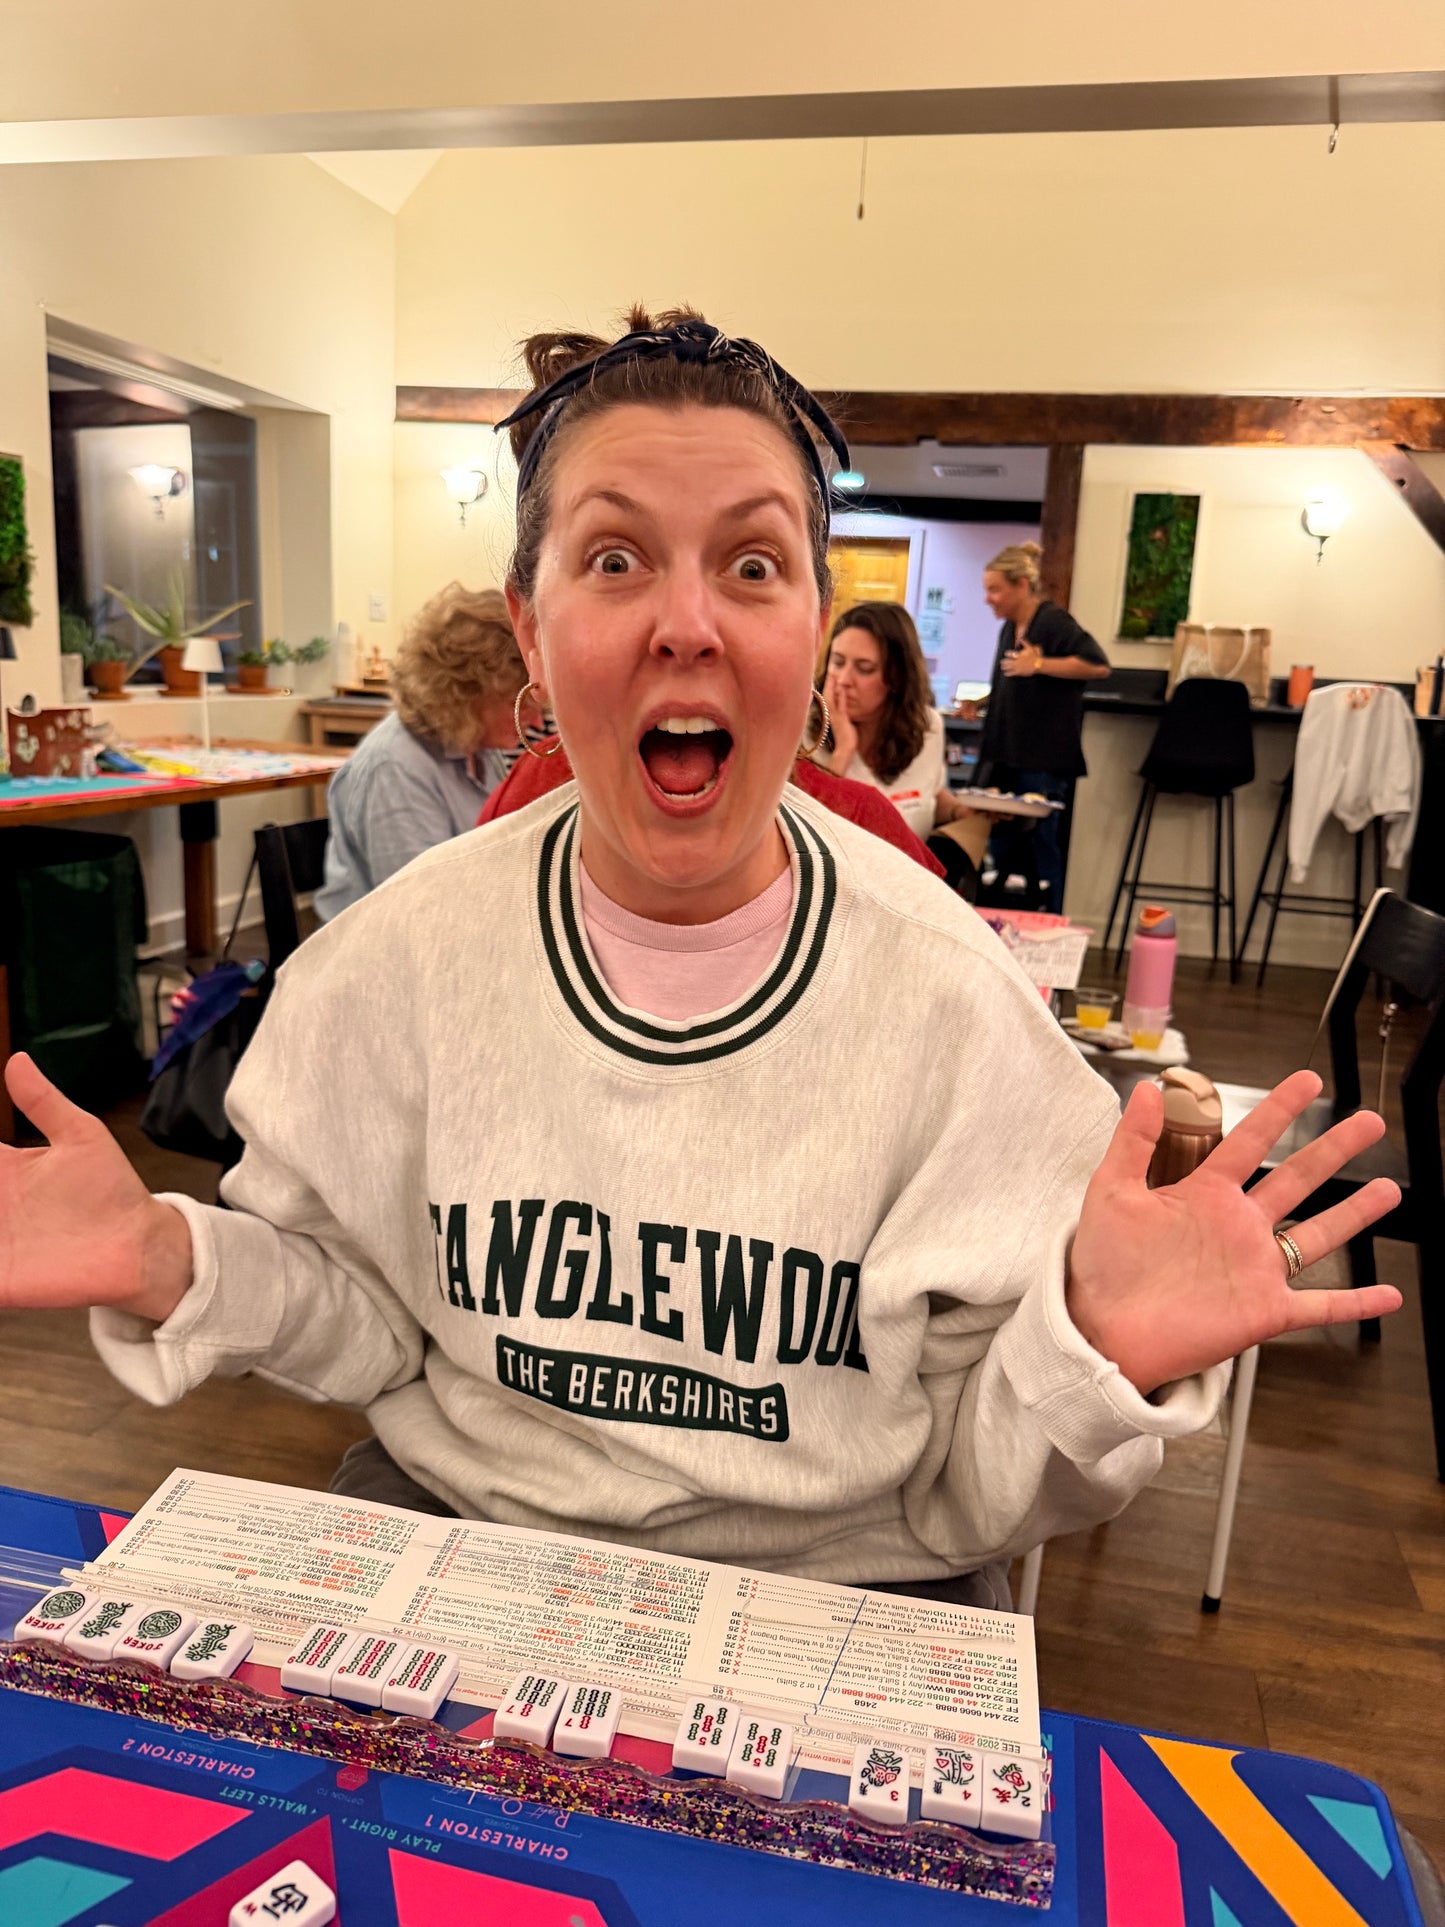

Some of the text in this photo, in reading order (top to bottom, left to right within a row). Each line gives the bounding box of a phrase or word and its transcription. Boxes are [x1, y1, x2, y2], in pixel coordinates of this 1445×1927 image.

[429, 1199, 869, 1373] ANGLEWOO
[502, 1346, 777, 1434] THE BERKSHIRES
[235, 1525, 260, 1534] PAIRS
[276, 1532, 310, 1542] SINGLES
[215, 1563, 237, 1571] 9999
[302, 1558, 331, 1567] NEWS
[286, 1592, 312, 1601] WWW
[312, 1597, 334, 1605] 2026
[544, 1598, 570, 1607] 13579
[25, 1616, 64, 1631] JOKER
[875, 1622, 894, 1630] LIKE
[897, 1626, 915, 1634] ANY
[123, 1636, 164, 1651] JOKER
[554, 1637, 575, 1646] 3333
[614, 1648, 634, 1656] 4444
[838, 1660, 871, 1672] Matching
[852, 1671, 866, 1679] and
[882, 1668, 900, 1676] Suits
[909, 1672, 925, 1680] (Any
[776, 1676, 798, 1686] Suits)
[926, 1675, 946, 1684] DDD
[949, 1679, 970, 1688] 8888
[877, 1684, 899, 1694] Suits)
[908, 1680, 924, 1689] (Any
[925, 1683, 943, 1691] WW
[973, 1683, 993, 1691] DDD
[841, 1687, 863, 1696] 8888
[864, 1691, 886, 1700] 6666
[908, 1689, 925, 1698] (Any
[976, 1691, 990, 1699] 444
[996, 1686, 1017, 1696] 2222
[889, 1695, 905, 1704] 444
[926, 1692, 949, 1701] 8888
[1005, 1696, 1017, 1704] EE
[854, 1698, 876, 1708] 2468
[907, 1698, 922, 1707] 222
[966, 1698, 977, 1706] 44
[980, 1701, 1002, 1710] 2222
[506, 1706, 515, 1714] 7
[935, 1702, 957, 1712] 8888
[960, 1707, 981, 1716] 6666
[1006, 1705, 1018, 1713] FF
[984, 1711, 1000, 1719] 444
[1002, 1714, 1018, 1722] 222
[564, 1718, 573, 1727] 7
[122, 1738, 133, 1751] 2
[699, 1736, 707, 1746] 5
[137, 1741, 256, 1779] CHARLESTON
[752, 1758, 761, 1767] 5
[823, 1755, 840, 1764] USED
[890, 1790, 899, 1802] 3
[962, 1789, 972, 1800] 4
[219, 1786, 308, 1815] WALLS LEFT
[1022, 1796, 1031, 1807] 2
[349, 1819, 442, 1854] PLAY RIGHT
[424, 1814, 569, 1860] CHARLESTON 1
